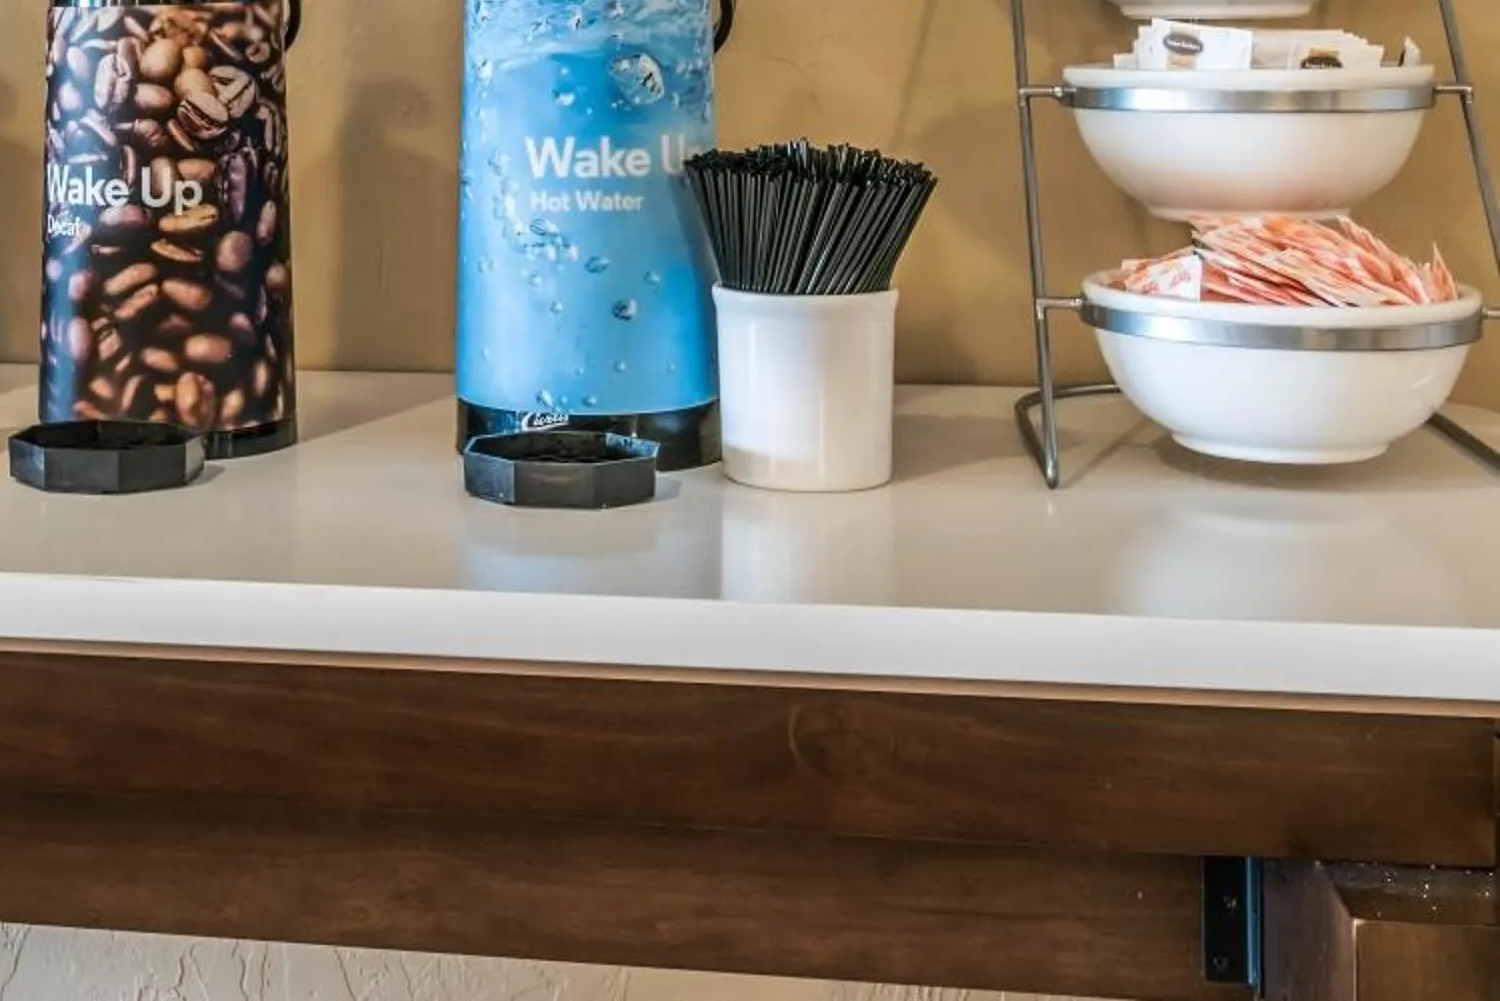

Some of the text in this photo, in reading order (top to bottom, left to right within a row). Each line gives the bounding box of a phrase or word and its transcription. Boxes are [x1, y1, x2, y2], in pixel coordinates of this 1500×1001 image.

[524, 132, 692, 179] Wake U
[47, 163, 203, 216] Wake Up
[529, 190, 645, 213] Hot Water
